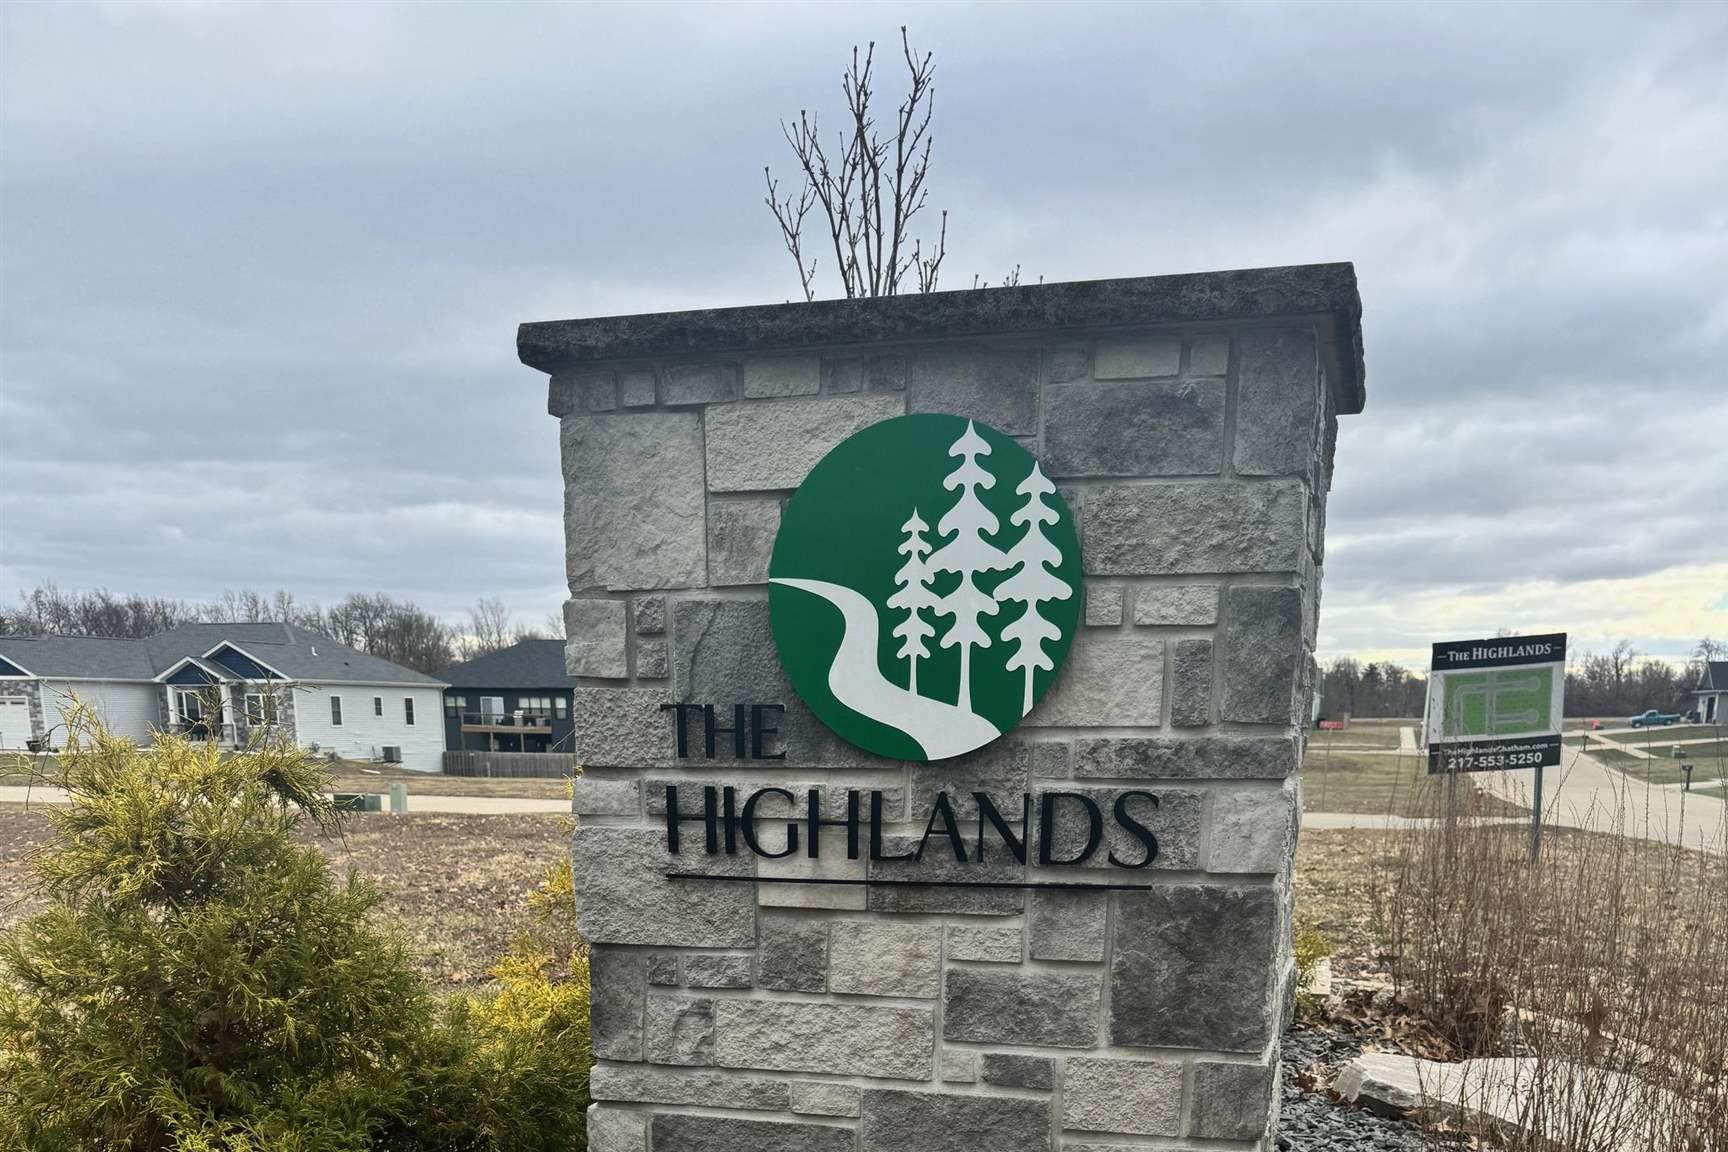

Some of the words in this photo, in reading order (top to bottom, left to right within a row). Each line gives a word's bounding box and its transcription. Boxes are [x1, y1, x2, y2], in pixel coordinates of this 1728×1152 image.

[660, 703, 787, 760] THE
[1447, 752, 1543, 769] 217-553-5250
[666, 785, 1160, 870] HIGHLANDS
